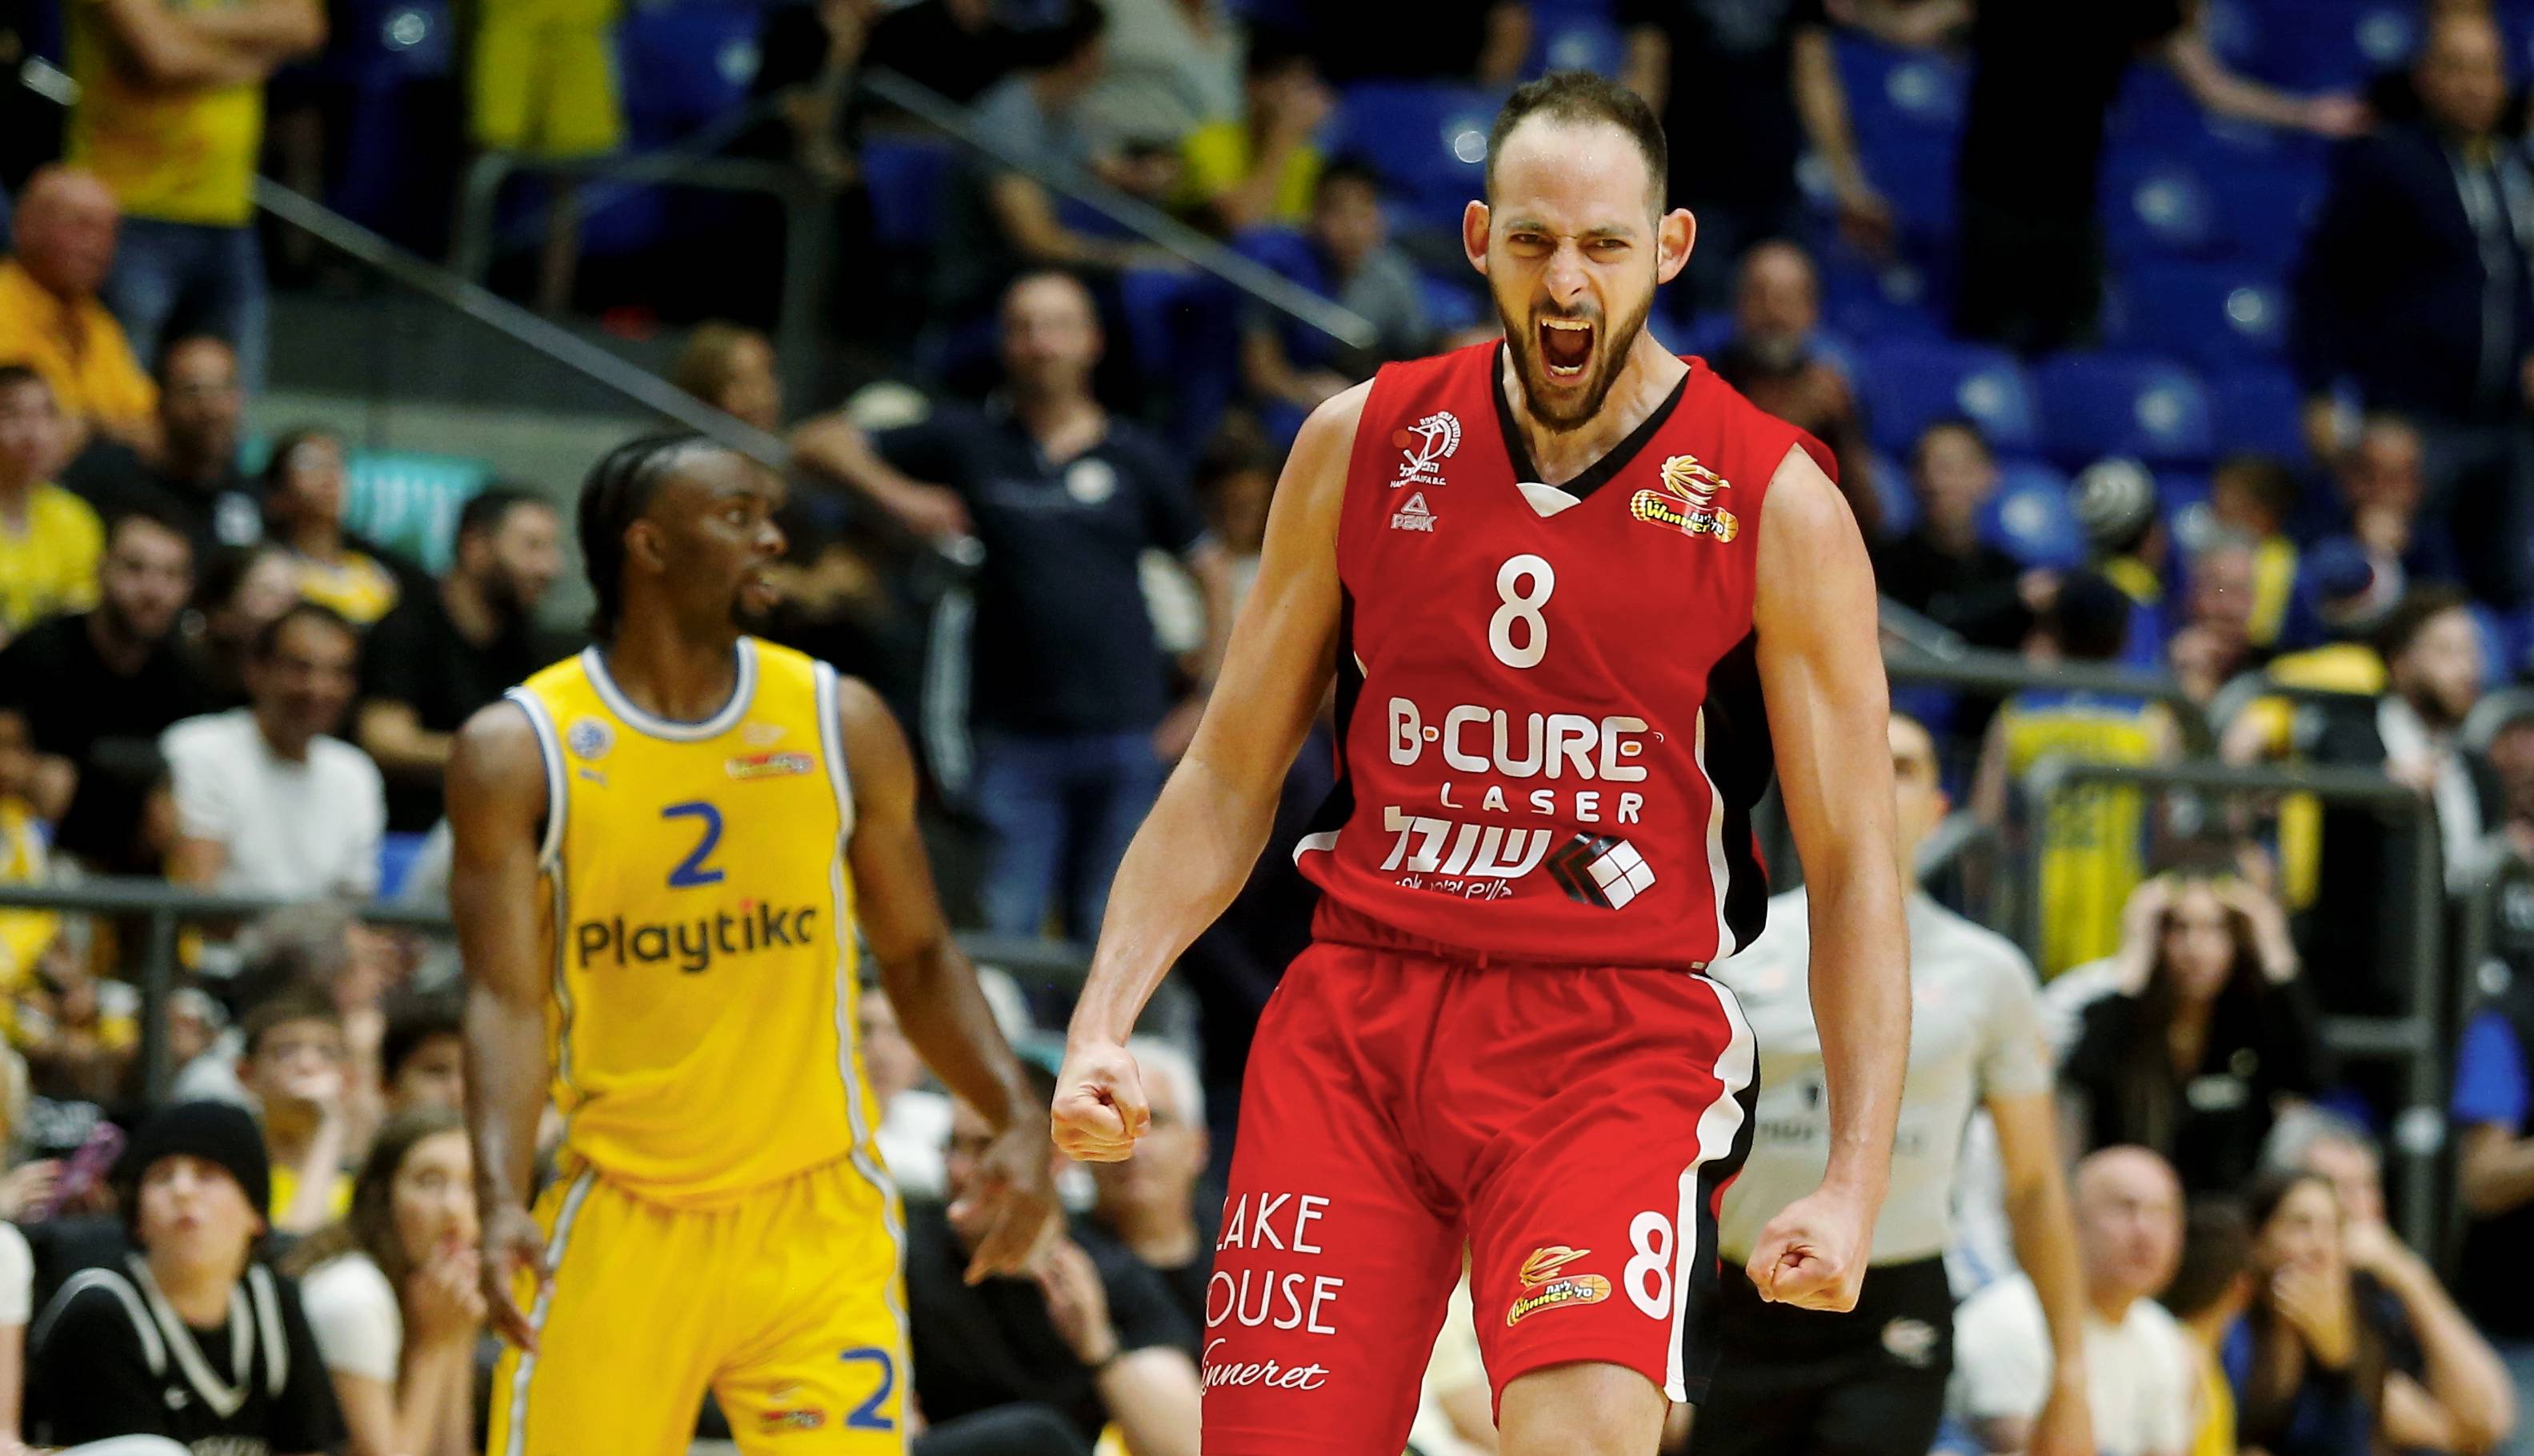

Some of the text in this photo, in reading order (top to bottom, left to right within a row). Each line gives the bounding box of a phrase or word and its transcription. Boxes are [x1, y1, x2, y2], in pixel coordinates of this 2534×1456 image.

[1391, 514, 1438, 532] PEAK
[1646, 499, 1710, 533] Winner
[1489, 554, 1555, 669] 8
[1441, 782, 1643, 824] LASER
[662, 802, 725, 888] 2
[1623, 1210, 1673, 1320] 8
[1206, 1270, 1343, 1335] OUSE
[1515, 1290, 1573, 1317] Winner
[840, 1347, 894, 1430] 2
